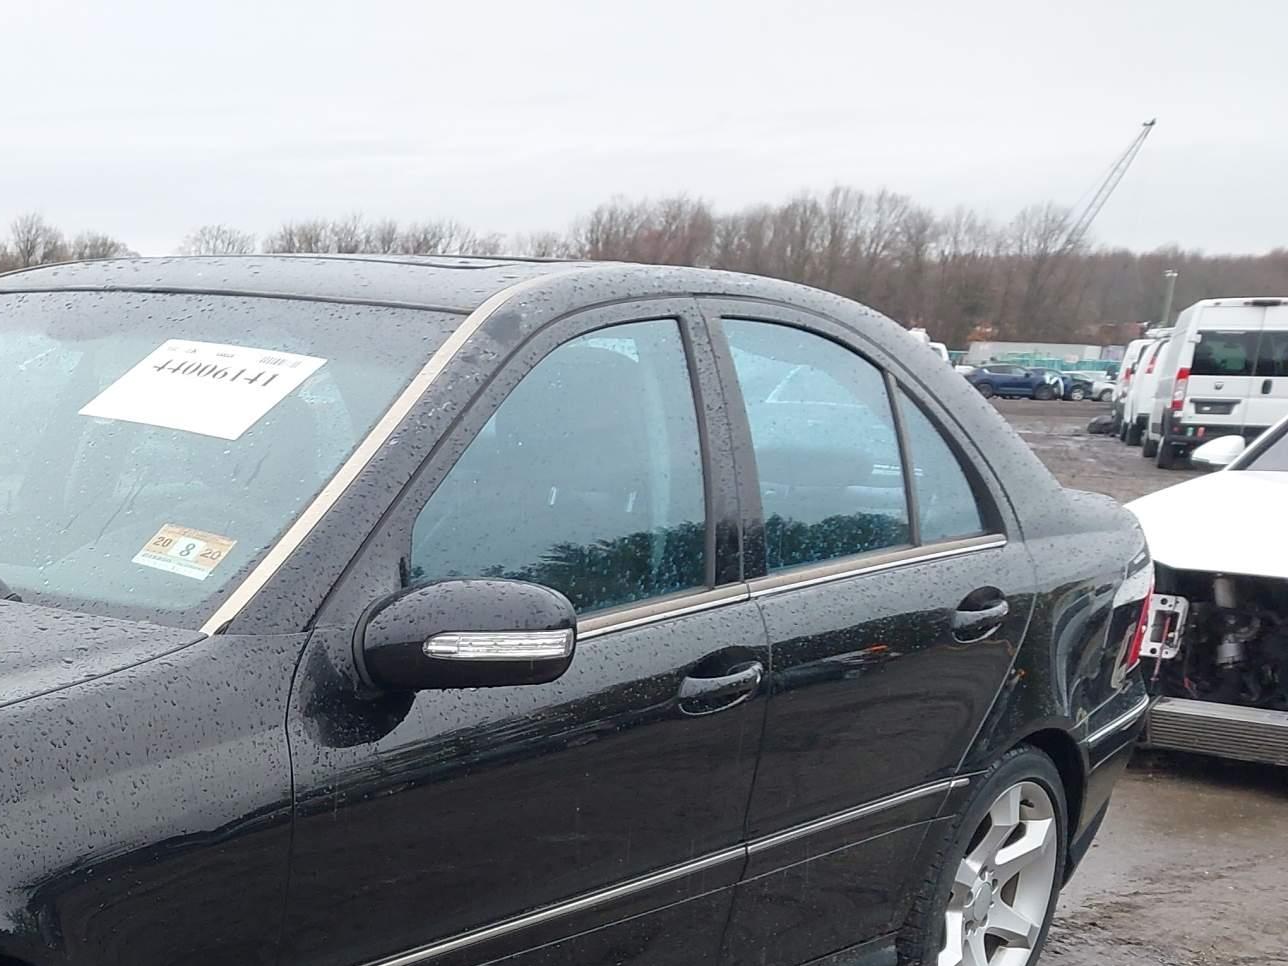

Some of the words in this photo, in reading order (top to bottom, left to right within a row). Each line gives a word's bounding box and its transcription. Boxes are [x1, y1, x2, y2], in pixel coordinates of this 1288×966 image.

[153, 359, 279, 387] 44006141
[153, 536, 173, 548] 20
[179, 543, 196, 557] 8
[200, 548, 222, 561] 20
